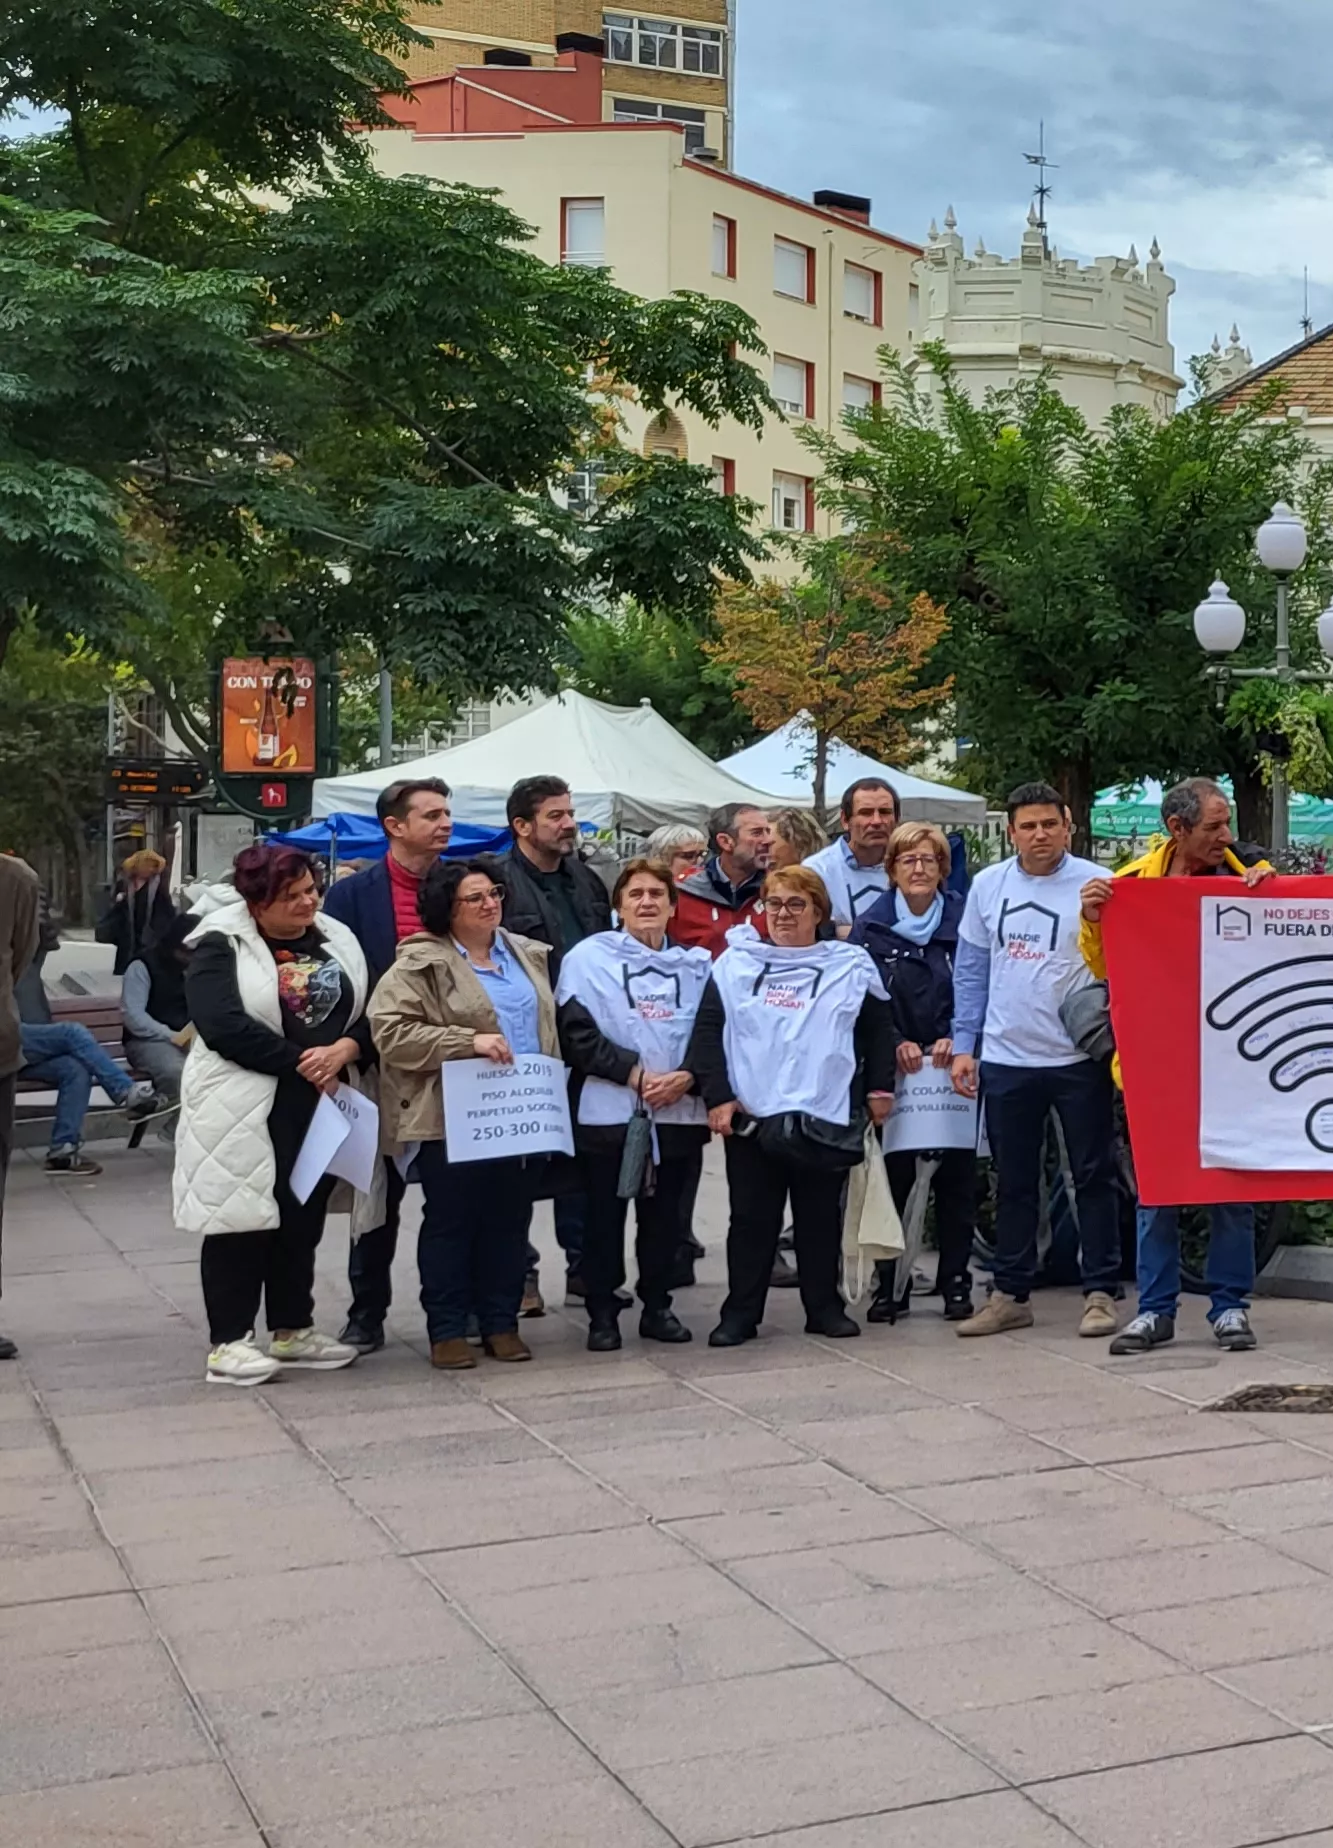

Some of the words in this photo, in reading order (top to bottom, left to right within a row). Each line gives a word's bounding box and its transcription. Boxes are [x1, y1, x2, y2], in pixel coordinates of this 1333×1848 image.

[227, 676, 257, 689] CON
[1263, 908, 1284, 920] NO
[1287, 908, 1330, 921] DEJES
[1264, 923, 1316, 937] FUERA
[1008, 932, 1041, 943] NADIE
[477, 1068, 520, 1080] HUESCA
[481, 1090, 507, 1101] PISO
[911, 1085, 956, 1096] COLAPS
[467, 1104, 524, 1118] PERPETUO
[472, 1120, 541, 1141] 250-300
